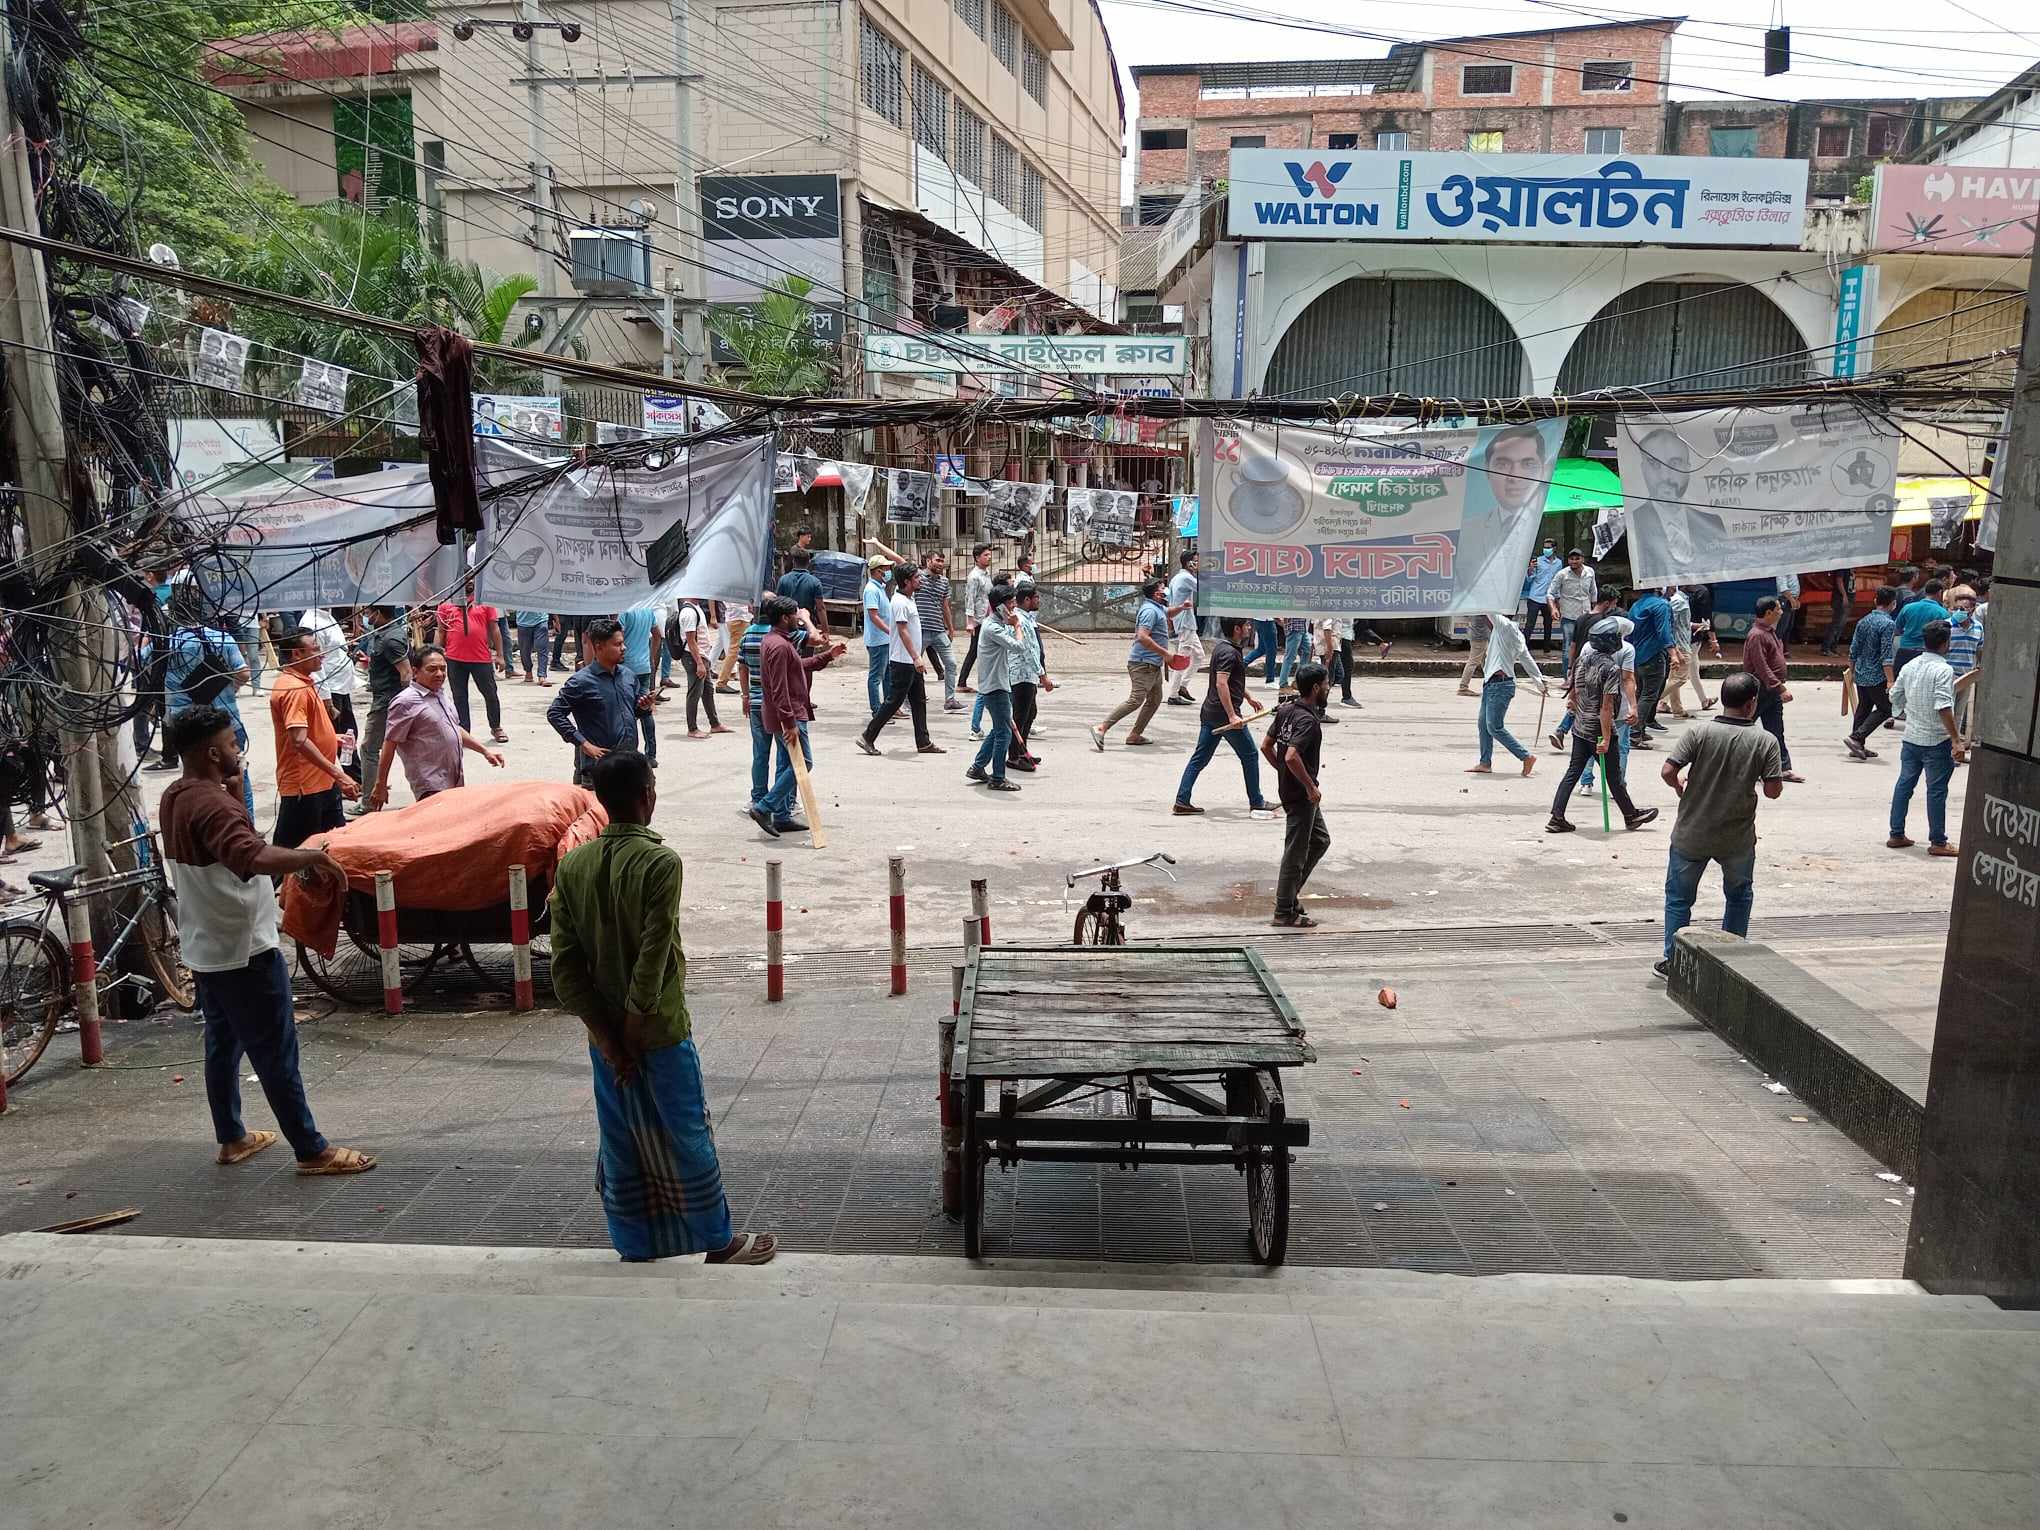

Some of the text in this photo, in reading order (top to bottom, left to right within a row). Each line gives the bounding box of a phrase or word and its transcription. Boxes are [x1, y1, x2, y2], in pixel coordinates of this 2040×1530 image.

[715, 196, 823, 219] SONY
[1399, 161, 1411, 228] waltonbd.com
[1426, 160, 1690, 233] ওয়ালটন
[1255, 202, 1379, 226] WALTON
[1000, 338, 1106, 365] রাইফেল
[1115, 344, 1176, 364] ক্লাব
